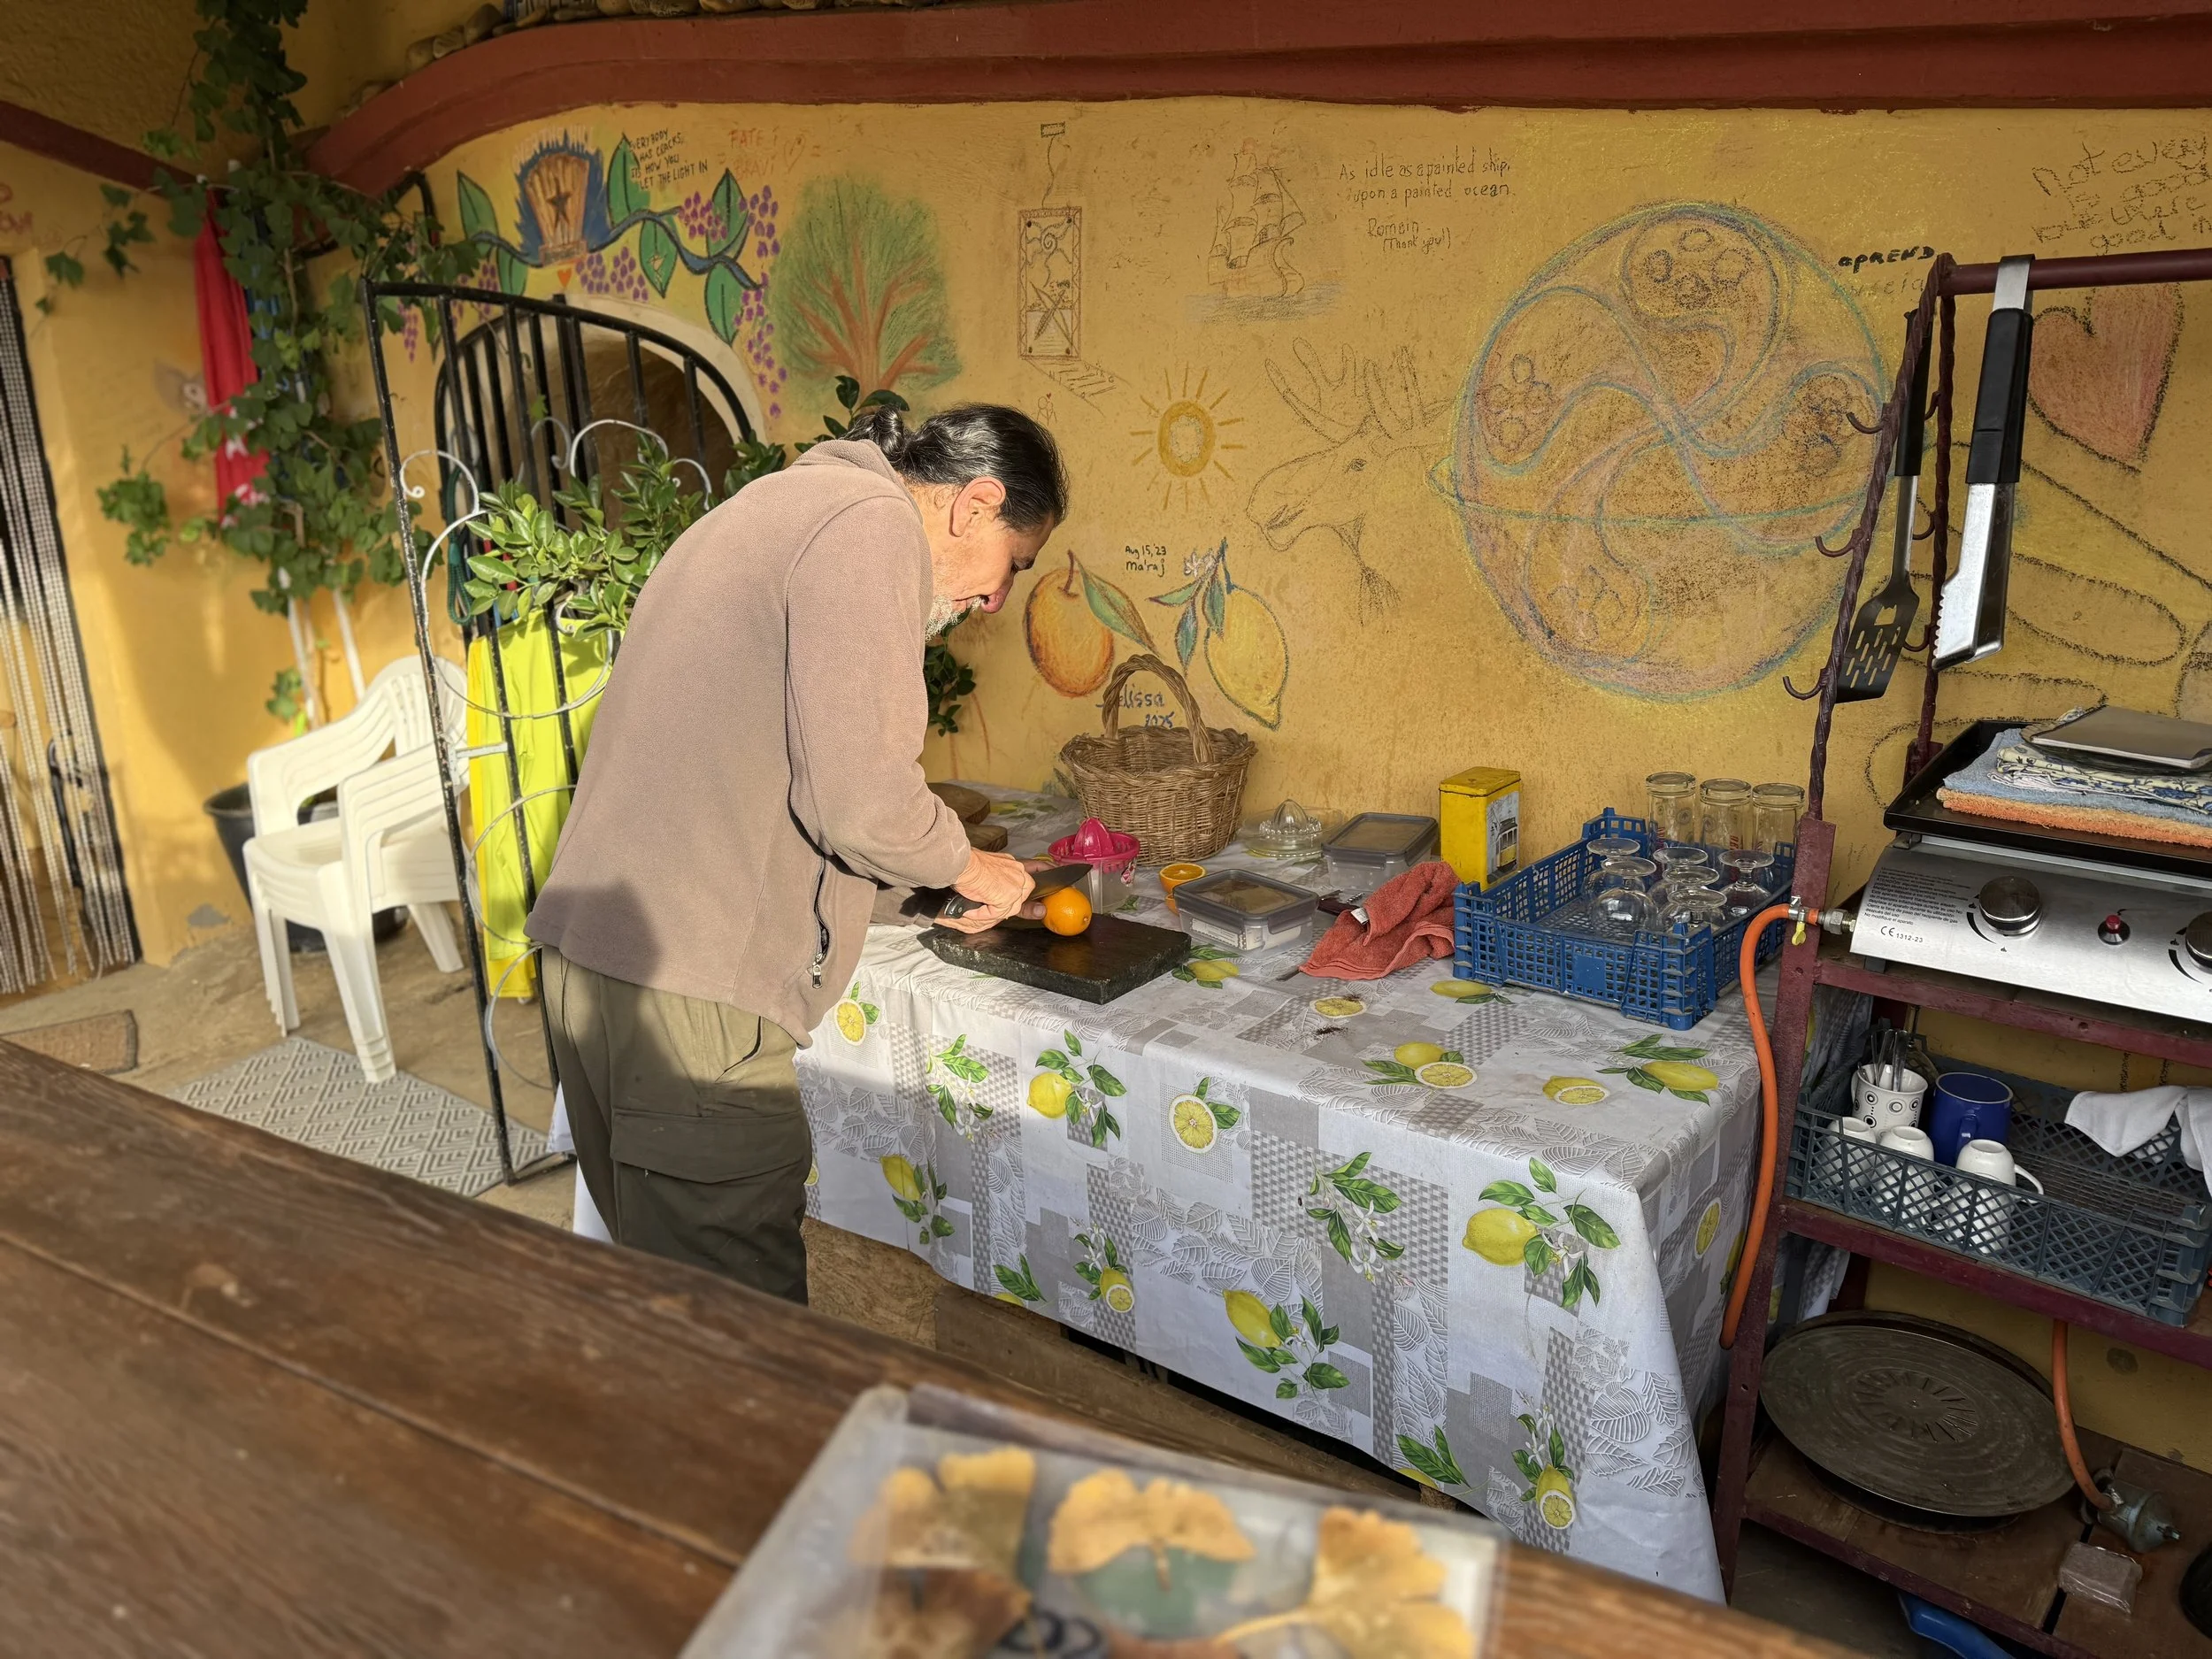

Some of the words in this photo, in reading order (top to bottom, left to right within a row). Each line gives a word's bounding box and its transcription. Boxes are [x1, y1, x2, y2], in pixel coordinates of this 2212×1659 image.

[640, 149, 652, 163] HAS
[645, 159, 661, 173] HOW
[664, 154, 680, 168] YOU
[1340, 164, 1356, 180] As
[1366, 153, 1394, 178] idle
[1400, 165, 1412, 176] as
[1417, 165, 1424, 176] a
[1427, 145, 1474, 185] painted
[640, 176, 653, 189] LET
[658, 172, 671, 184] THE
[673, 163, 695, 180] LIGHT
[698, 159, 708, 173] IN
[1391, 188, 1397, 199] a
[1404, 179, 1452, 207] painted
[1125, 545, 1140, 559] Aug
[1896, 933, 1924, 943] 1312-23
